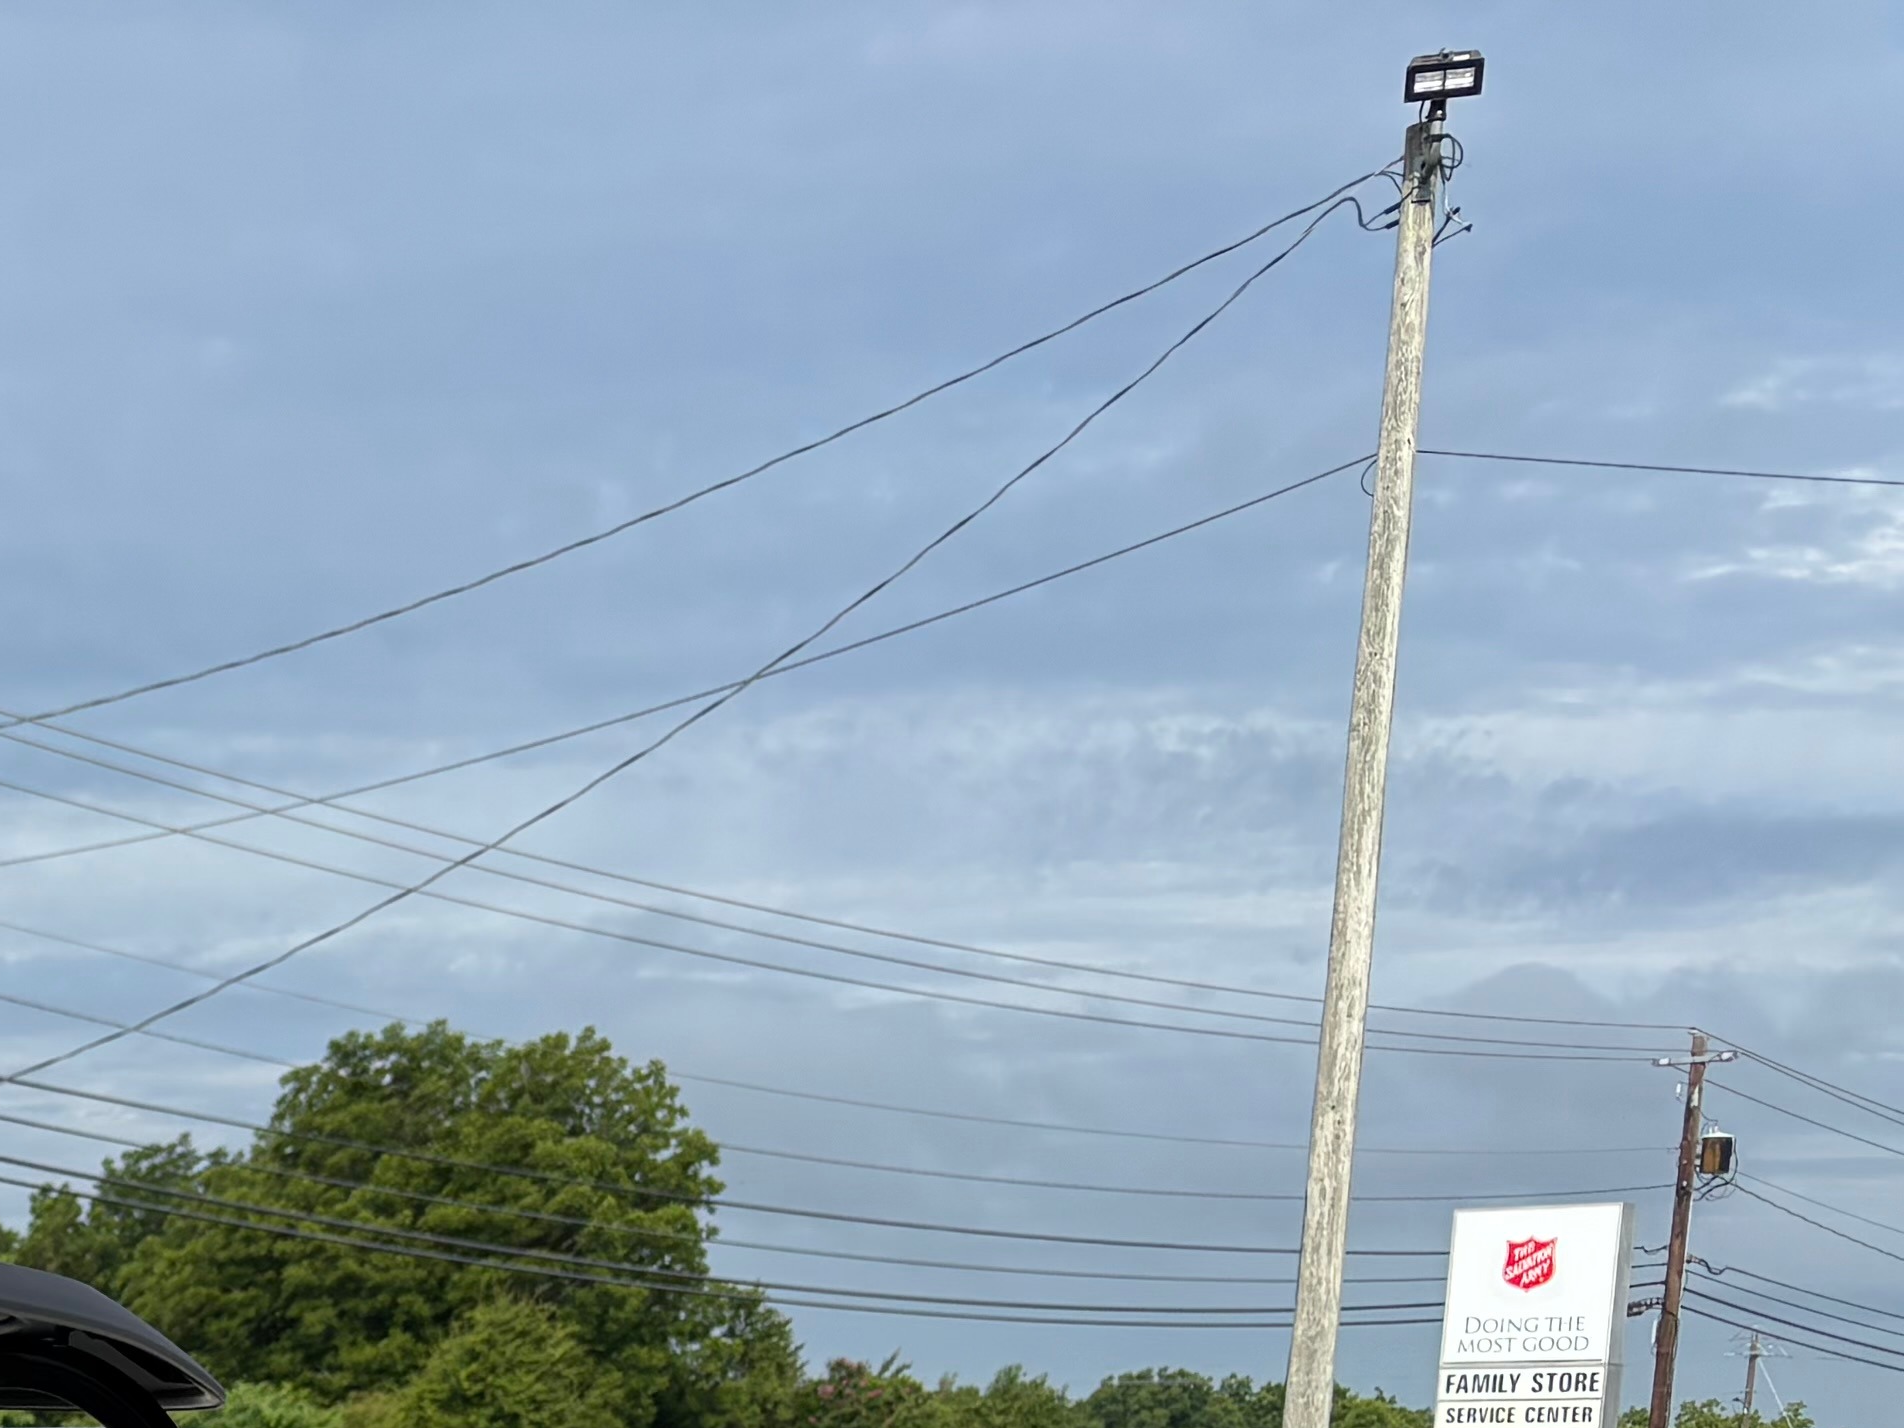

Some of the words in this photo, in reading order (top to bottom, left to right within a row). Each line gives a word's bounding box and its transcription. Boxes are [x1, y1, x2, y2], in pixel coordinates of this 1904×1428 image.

[1504, 1243, 1554, 1281] SALVATION
[1513, 1240, 1536, 1262] THE
[1519, 1259, 1551, 1289] ARMY
[1465, 1316, 1539, 1334] DOING
[1544, 1316, 1585, 1332] THE
[1457, 1337, 1517, 1353] MOST
[1522, 1335, 1589, 1352] GOOD
[1445, 1373, 1521, 1394] FAMILY
[1531, 1372, 1600, 1393] STORE
[1445, 1407, 1516, 1424] SERVICE
[1524, 1406, 1593, 1423] CENTER
